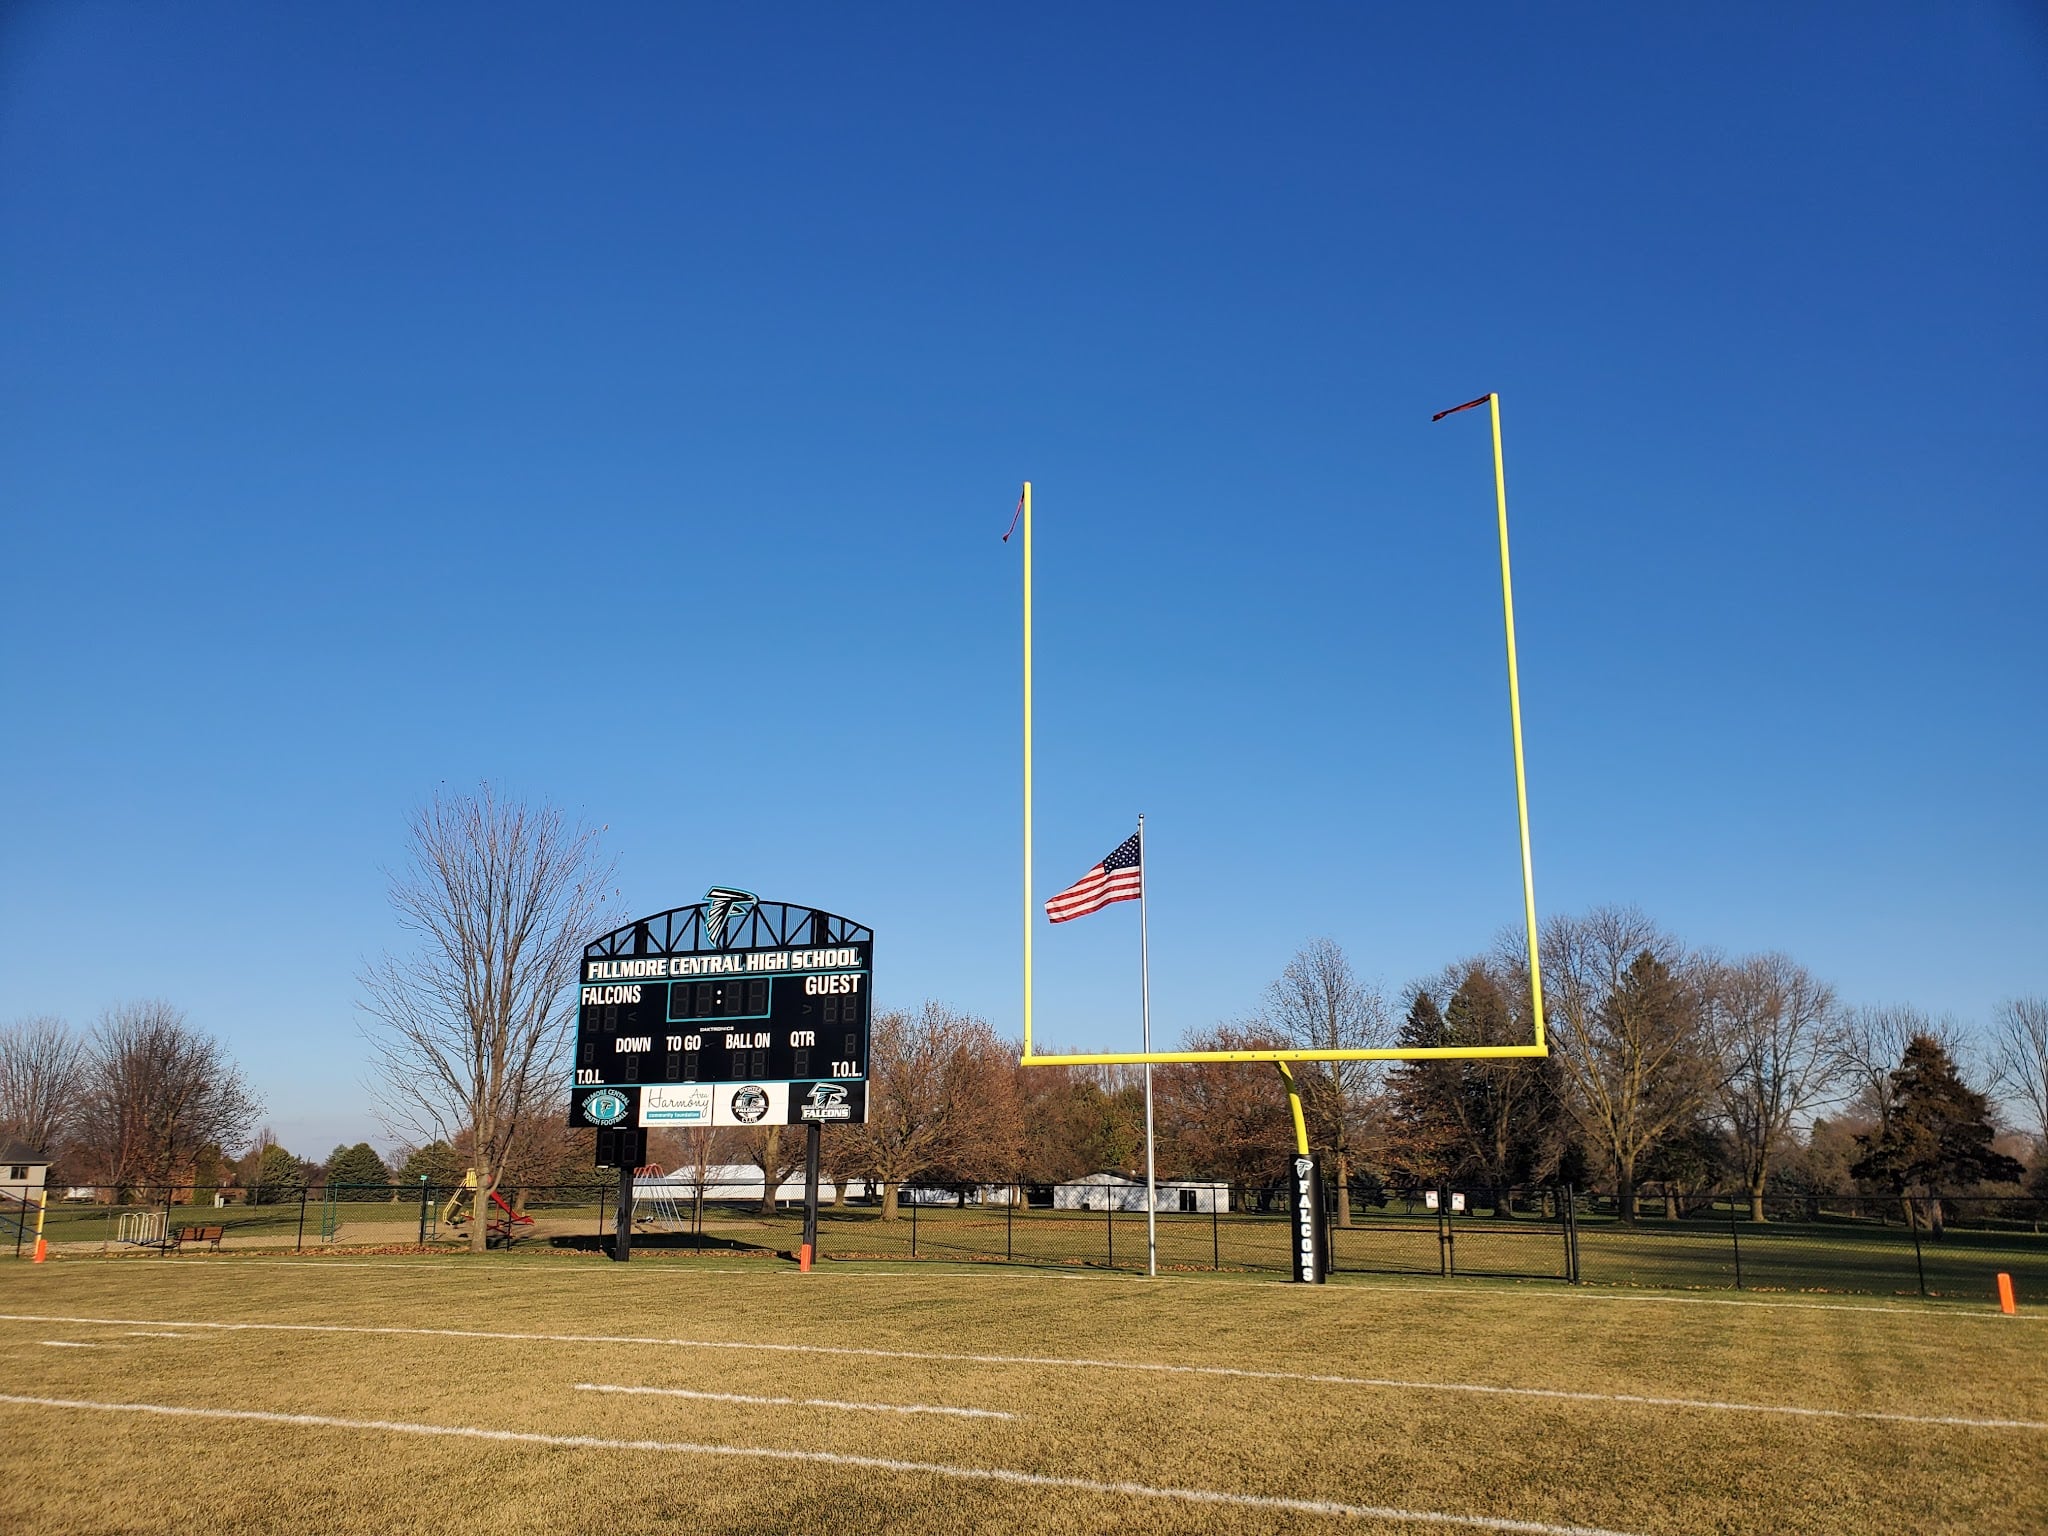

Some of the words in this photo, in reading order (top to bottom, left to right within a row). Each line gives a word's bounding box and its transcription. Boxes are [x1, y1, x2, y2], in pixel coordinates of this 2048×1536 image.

[588, 959, 668, 980] FILLMORE
[670, 955, 744, 976] CENTRAL
[746, 952, 789, 971] HIGH
[791, 948, 861, 968] SCHOOL
[805, 974, 861, 996] GUEST
[581, 985, 641, 1006] FALCONS
[615, 1037, 652, 1053] DOWN
[666, 1035, 682, 1052] TO
[684, 1034, 702, 1051] GO
[725, 1033, 753, 1049] BALL
[754, 1032, 771, 1048] ON
[790, 1031, 815, 1048] QTR
[577, 1068, 604, 1084] T.O.L.
[832, 1061, 862, 1077] T.O.L.
[582, 1088, 607, 1108] FILLMORE
[607, 1088, 630, 1106] CENTRAL
[648, 1087, 709, 1118] Harmony
[582, 1110, 600, 1126] YOUTH
[600, 1110, 629, 1126] FOOTBALL
[803, 1109, 849, 1119] FALCONS
[1298, 1180, 1314, 1282] FALCONS
